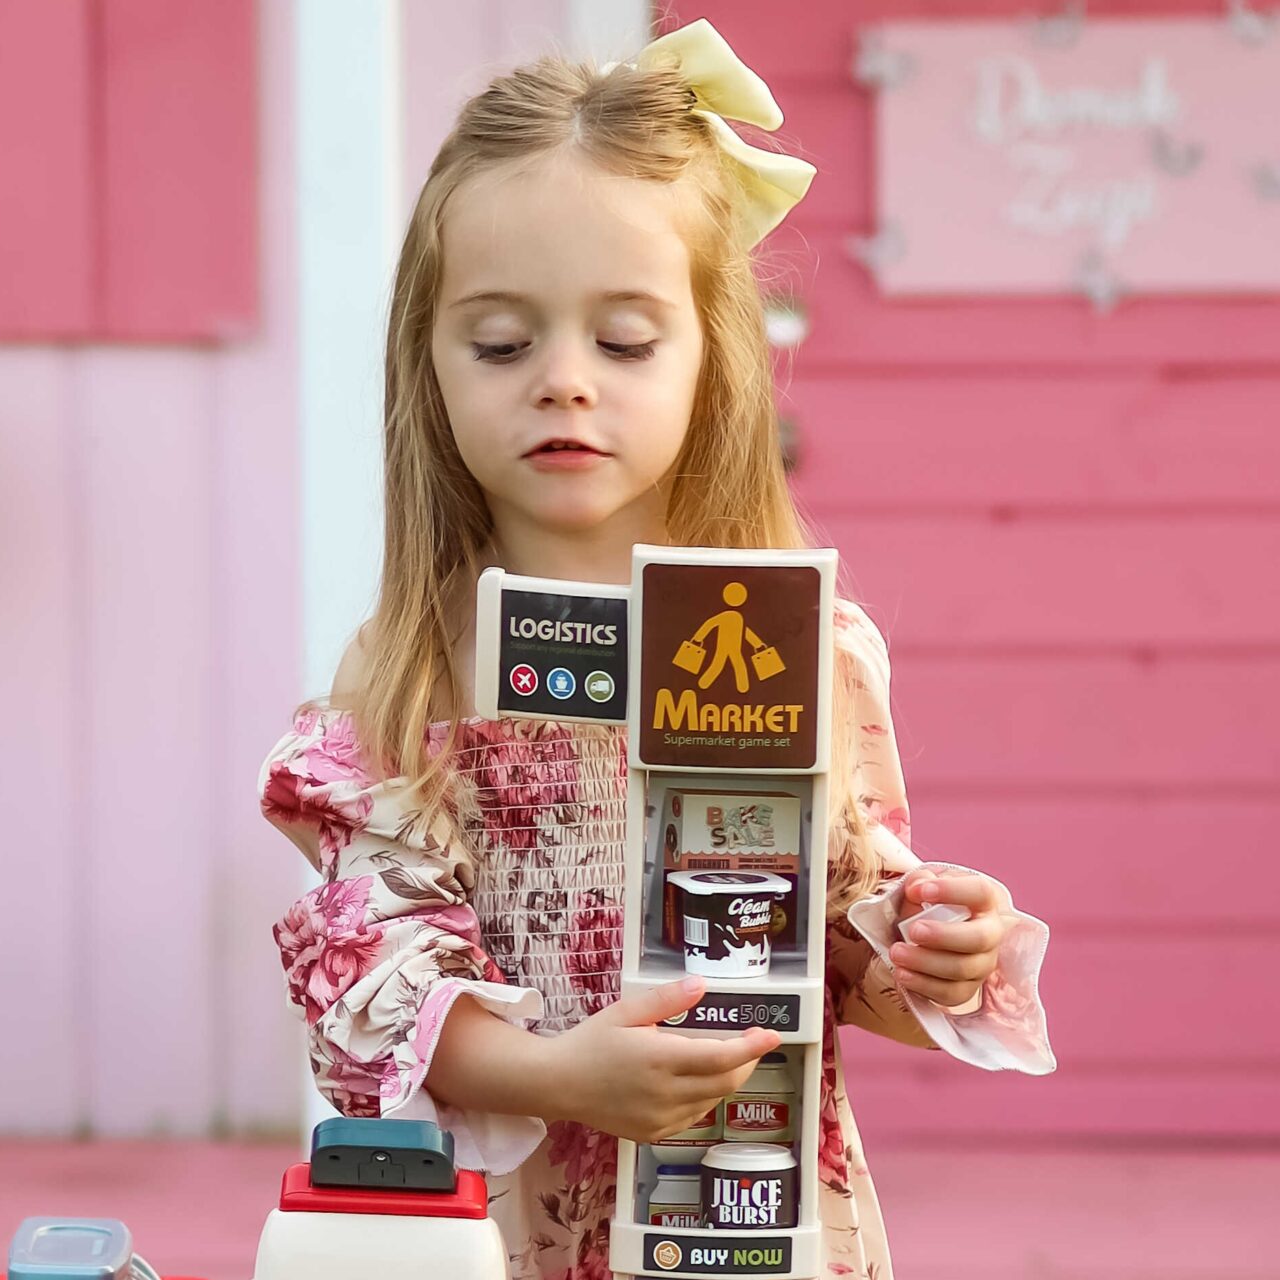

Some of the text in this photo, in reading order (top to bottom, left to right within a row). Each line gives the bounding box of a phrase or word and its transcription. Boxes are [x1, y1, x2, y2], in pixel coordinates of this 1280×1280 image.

[510, 616, 617, 646] LOGISTICS
[652, 688, 804, 733] MARKET
[664, 733, 791, 750] Supermarket game set
[706, 804, 773, 828] BAKE
[711, 826, 775, 849] SALE
[728, 898, 771, 915] Cream
[739, 912, 771, 928] Bubbl
[695, 1004, 790, 1024] SALE 50%
[737, 1103, 776, 1121] Milk
[661, 1215, 701, 1228] Milk
[718, 1205, 778, 1225] BURST
[690, 1247, 783, 1266] BUY NOW
